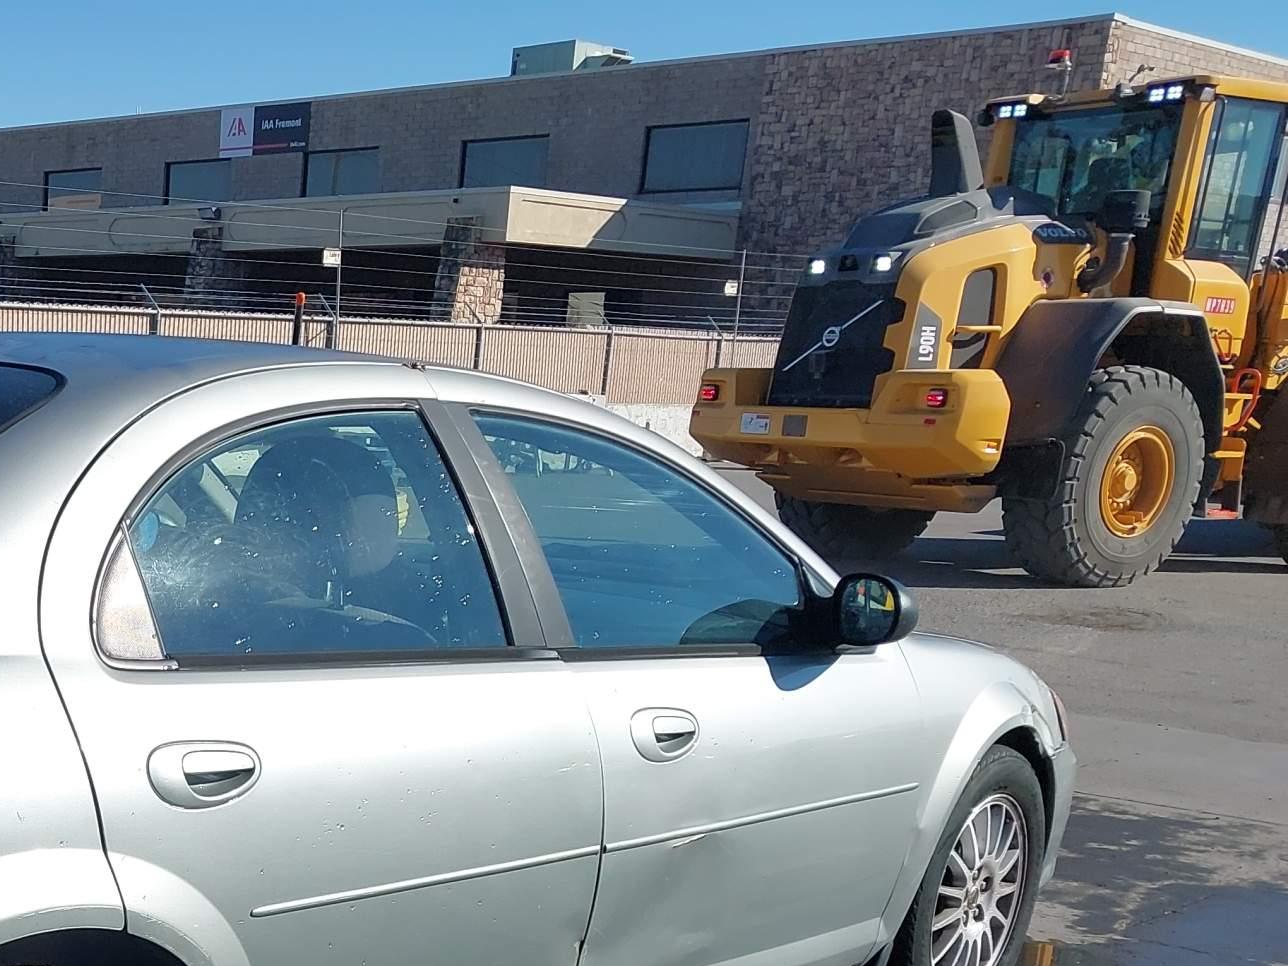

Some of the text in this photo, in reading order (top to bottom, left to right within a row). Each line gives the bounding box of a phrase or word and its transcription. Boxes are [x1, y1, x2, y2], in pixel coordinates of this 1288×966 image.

[261, 118, 302, 129] IAA Fremont
[918, 326, 937, 361] L90H
